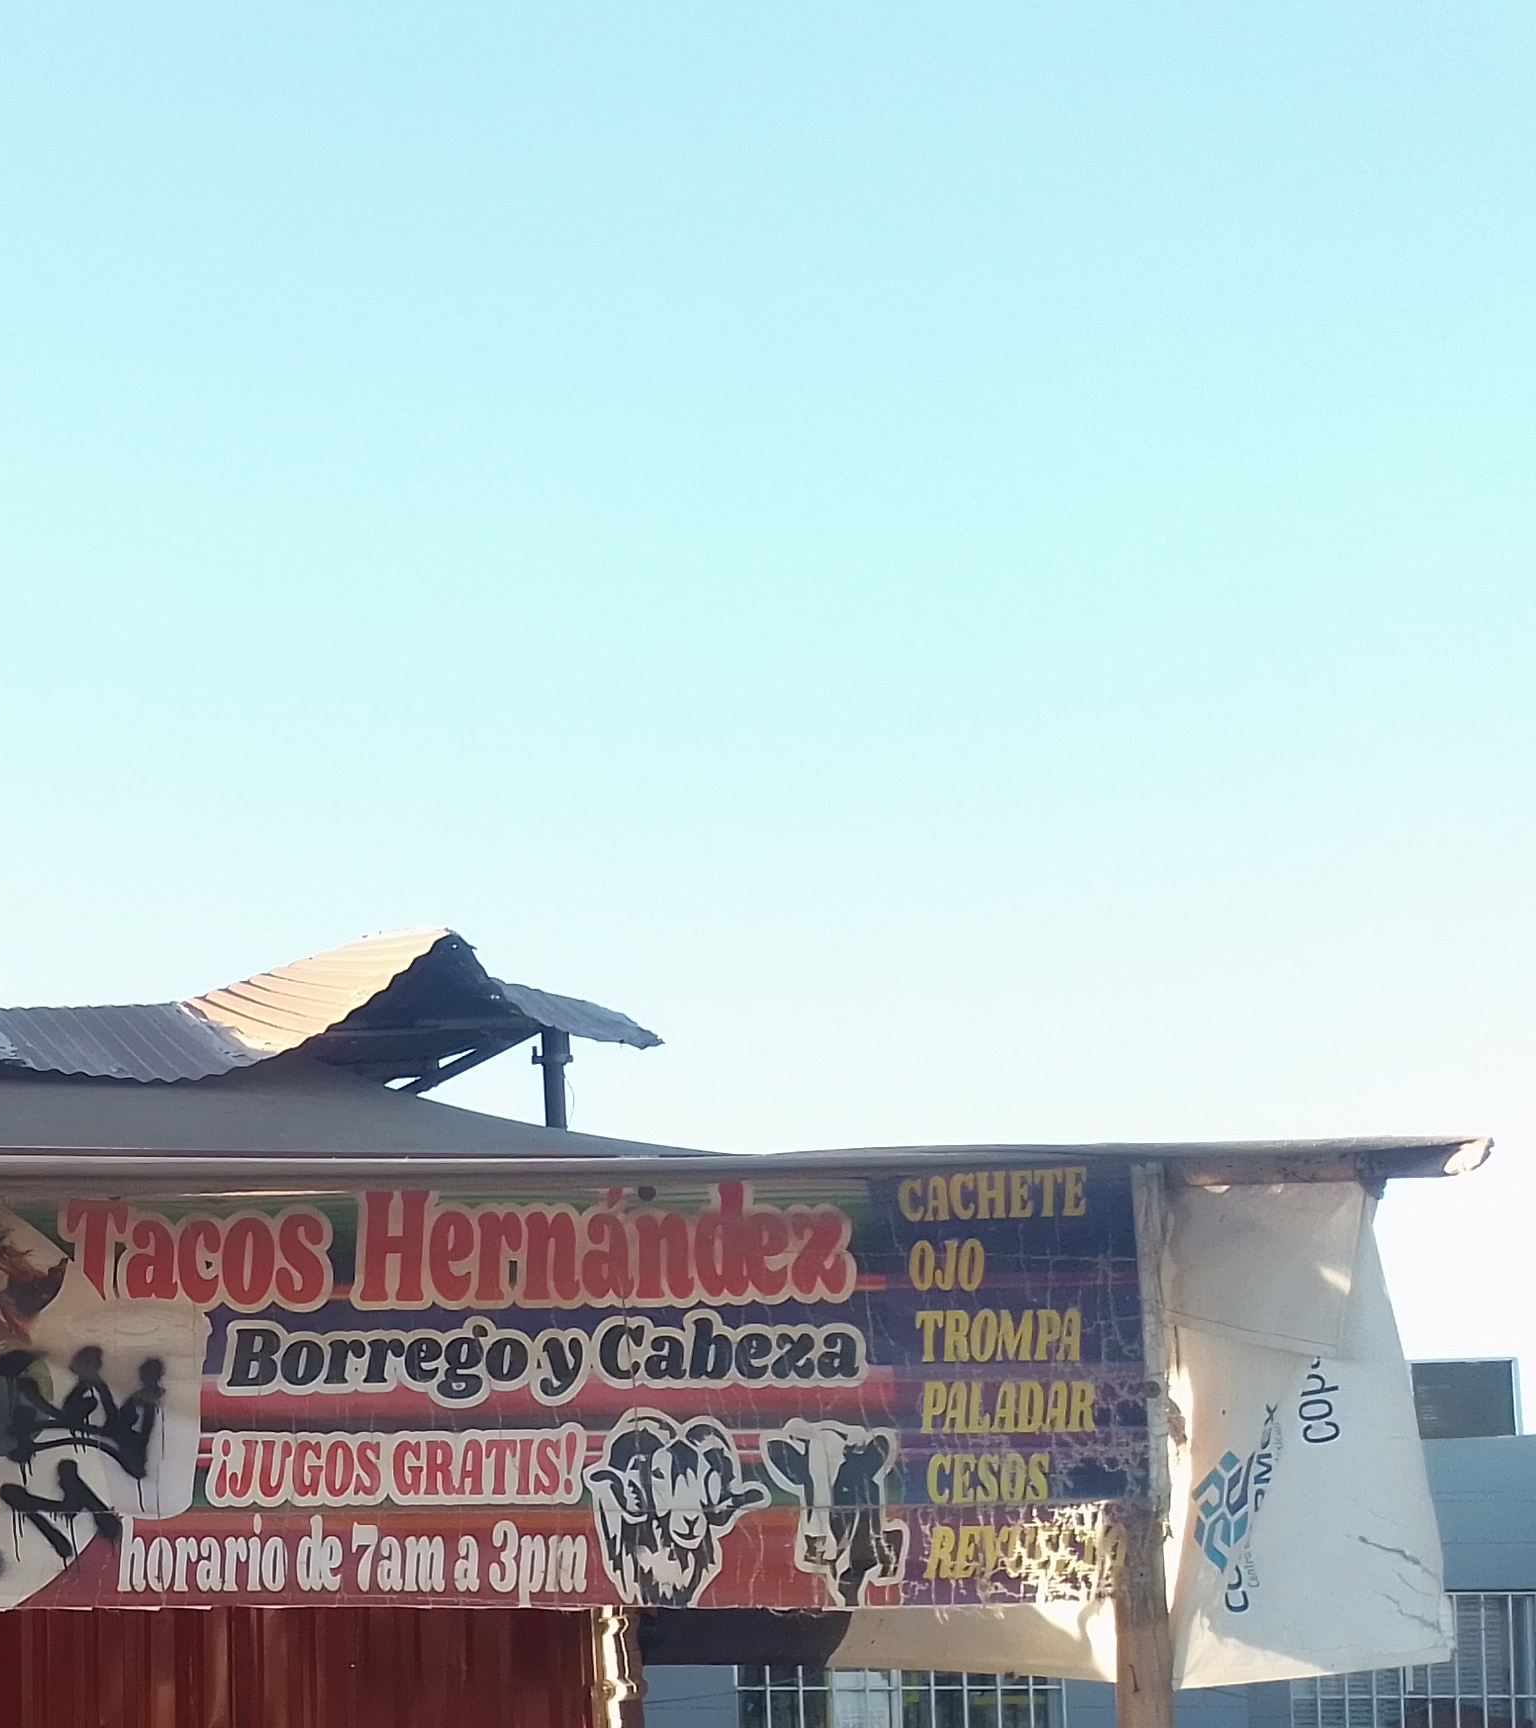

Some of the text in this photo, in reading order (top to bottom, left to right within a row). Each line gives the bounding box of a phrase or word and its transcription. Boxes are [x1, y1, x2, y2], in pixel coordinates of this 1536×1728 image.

[897, 1166, 1088, 1222] CACHETE
[64, 1180, 850, 1306] Tacos Hernández
[908, 1238, 985, 1292] OJO
[227, 1317, 860, 1401] Borrego y Cabeza
[915, 1308, 1082, 1363] TROMPA
[920, 1381, 1096, 1434] PALADAR
[213, 1424, 581, 1498] ¡JUGOS GRATIS!
[927, 1453, 1049, 1505] CESOS
[116, 1515, 288, 1594] horario
[296, 1515, 343, 1592] de
[351, 1521, 446, 1593] 7am
[454, 1536, 481, 1592] a
[490, 1520, 588, 1606] 3pm
